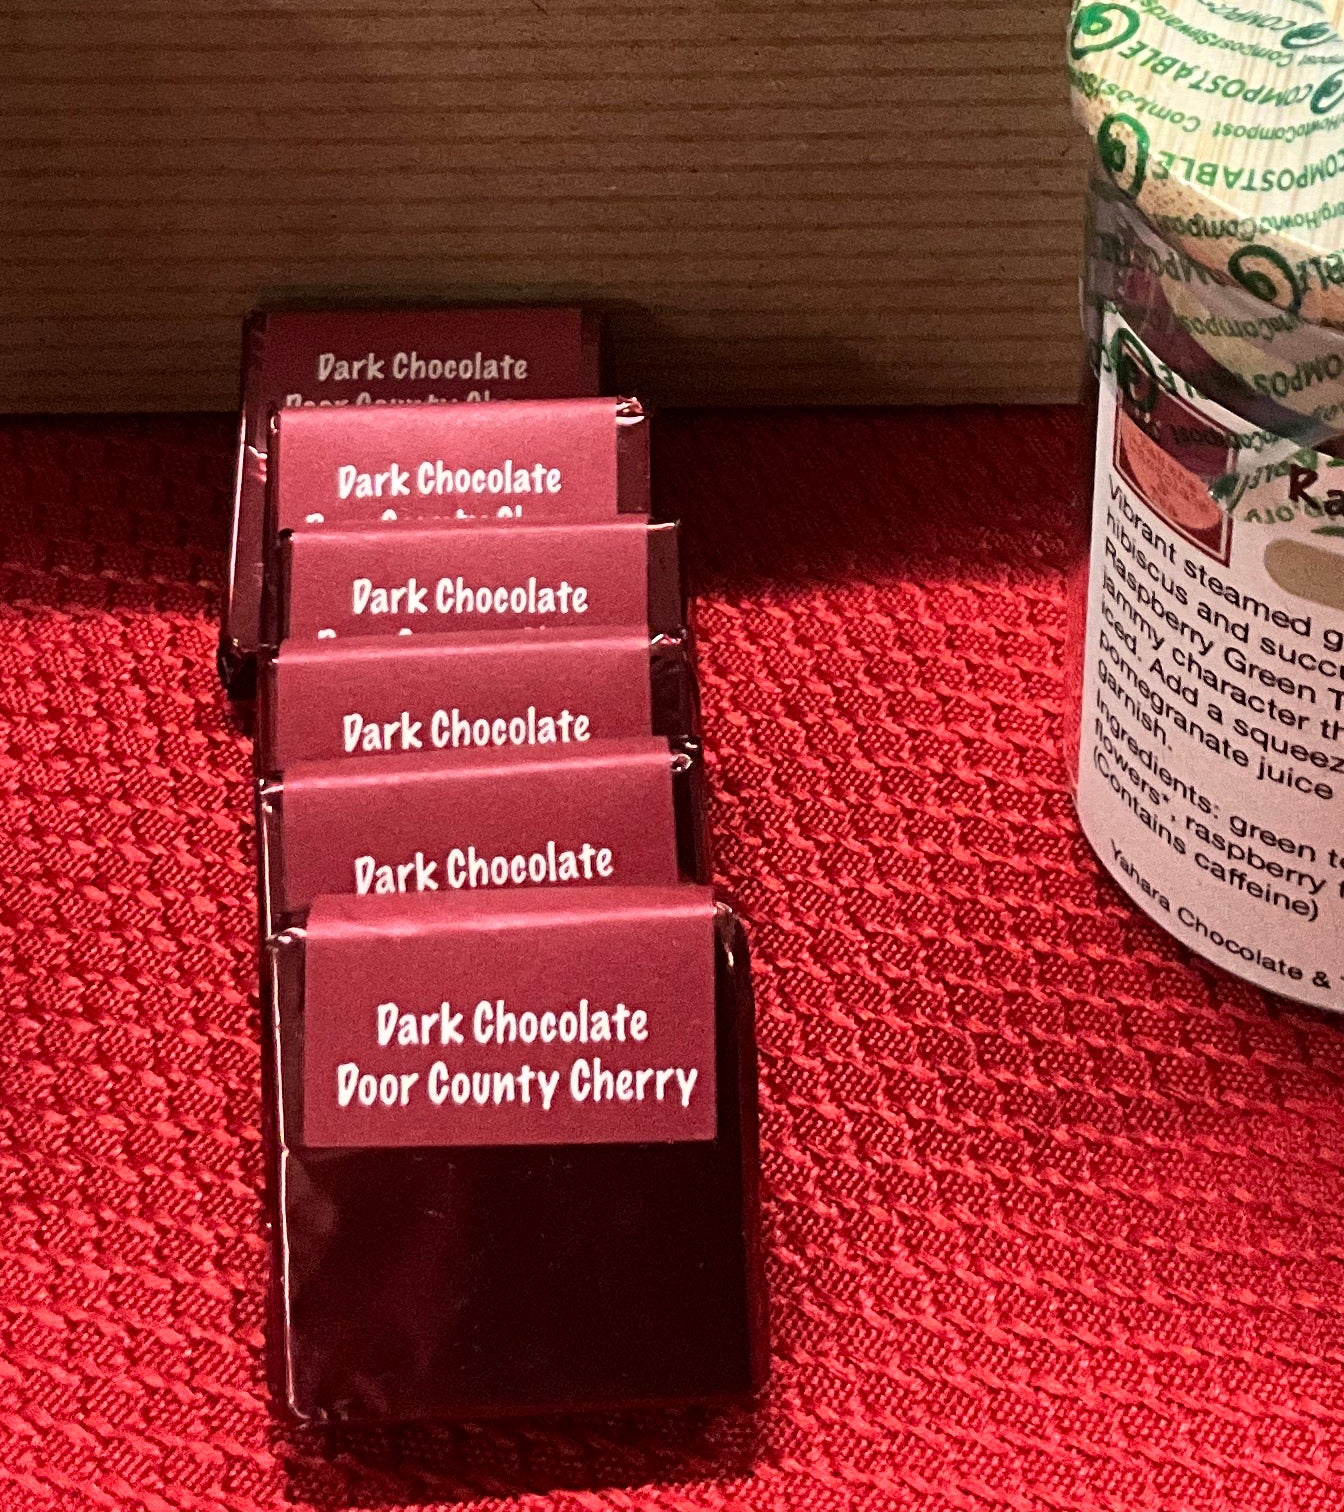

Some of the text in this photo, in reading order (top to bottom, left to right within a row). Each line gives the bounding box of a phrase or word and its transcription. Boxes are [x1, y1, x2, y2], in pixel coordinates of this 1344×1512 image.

[317, 351, 528, 381] Dark Chocolate
[338, 460, 562, 500] Dark Chocolate
[352, 577, 588, 615] Dark Chocolate
[1107, 506, 1188, 606] hibiscus
[1197, 600, 1249, 643] and
[1184, 558, 1311, 637] steamed
[1106, 537, 1214, 655] Raspberry
[1225, 647, 1316, 703] Green
[1098, 659, 1173, 751] garnish.
[1150, 658, 1199, 708] Add
[1208, 702, 1224, 725] a
[1172, 647, 1310, 730] character
[342, 706, 591, 752] Dark Chocolate
[1097, 689, 1316, 862] Ingredients: green
[1257, 757, 1334, 800] juice
[354, 841, 614, 895] Dark Chocolate
[1185, 813, 1326, 895] raspberry
[1194, 852, 1318, 922] caffeine)
[1110, 838, 1171, 912] Yahara
[1177, 906, 1303, 980] Chocolate
[377, 999, 649, 1046] Dark Chocolate
[337, 1057, 699, 1110] Door County Cherry
